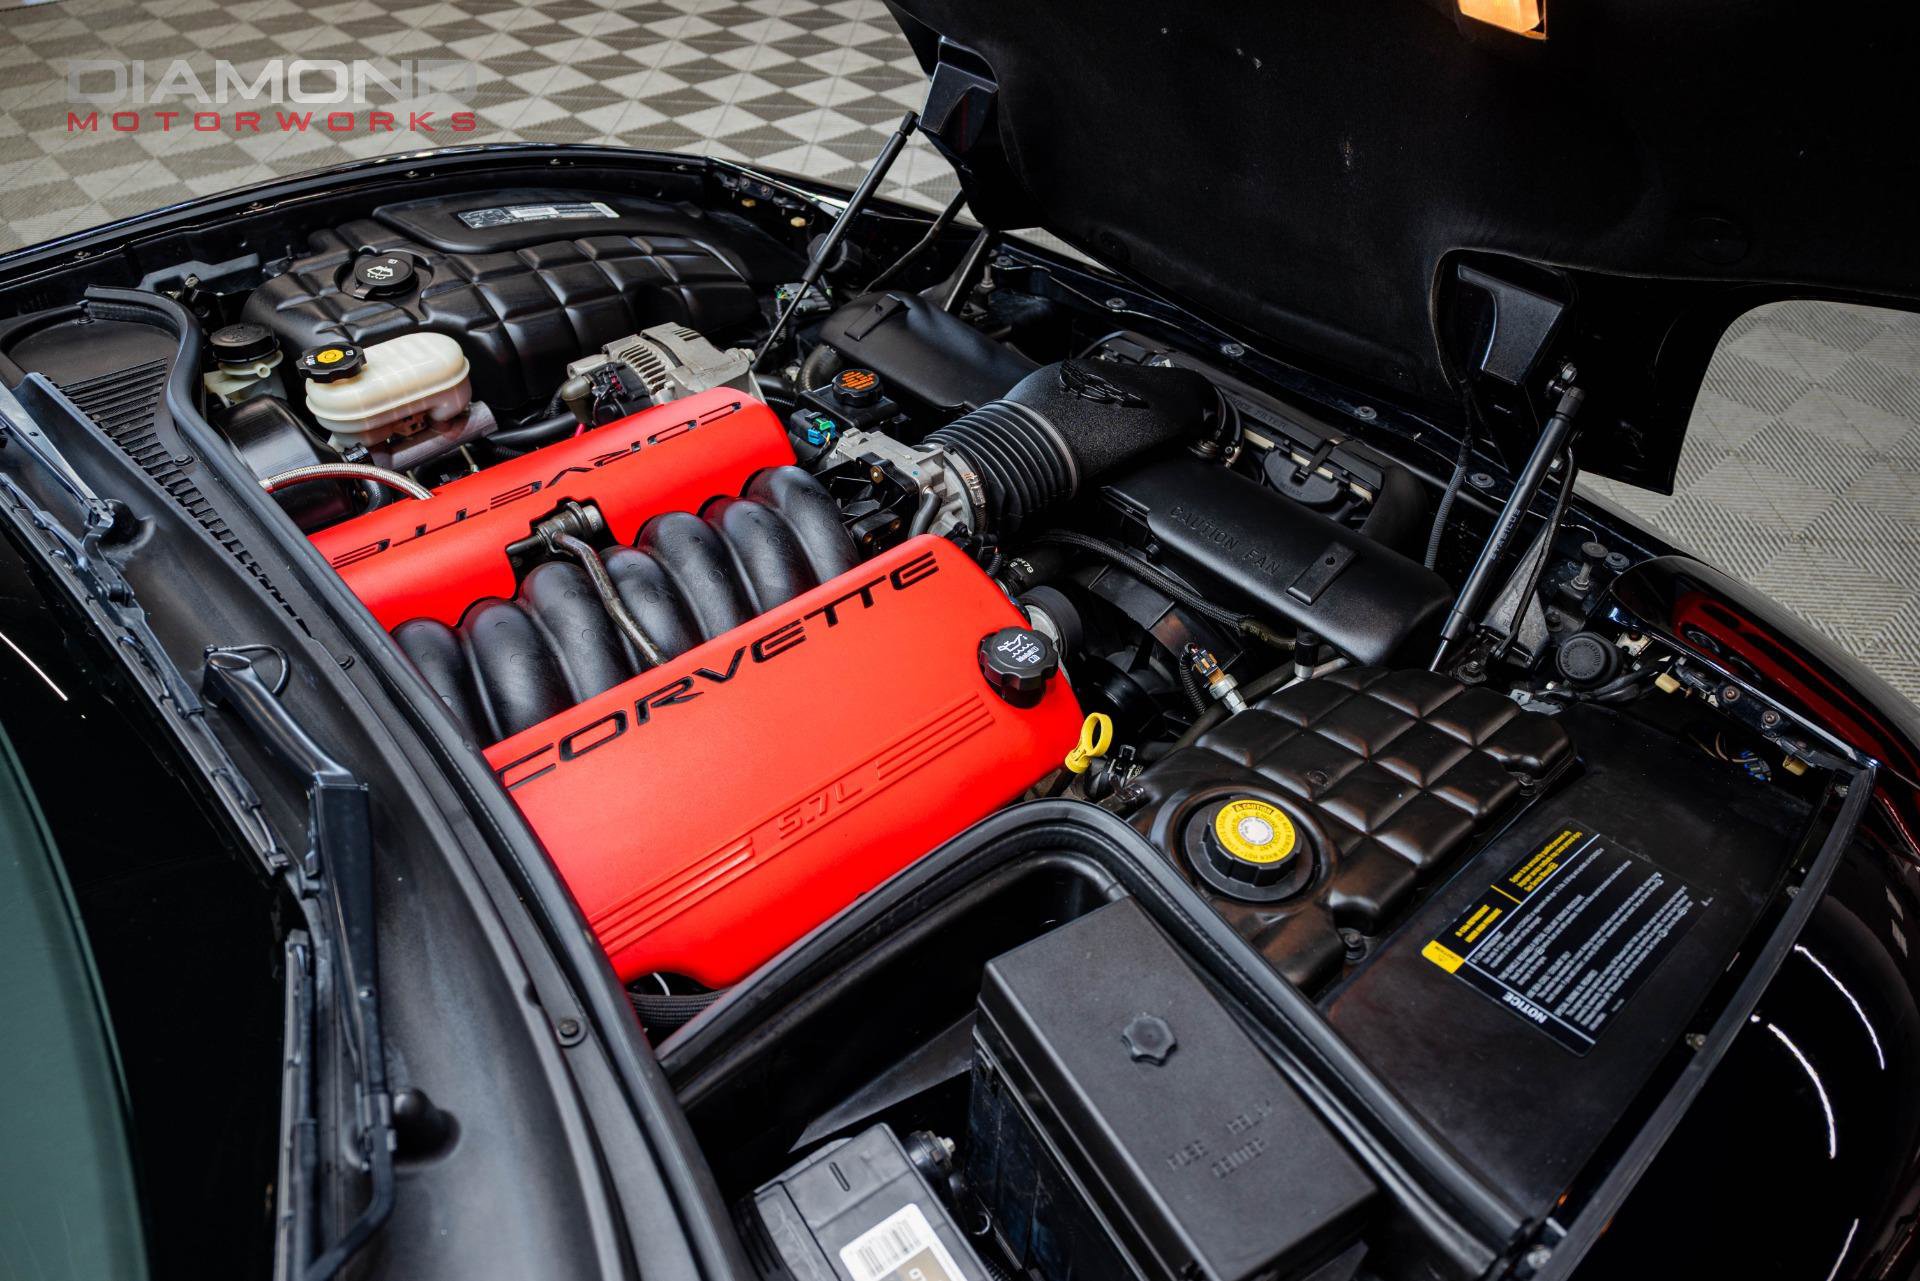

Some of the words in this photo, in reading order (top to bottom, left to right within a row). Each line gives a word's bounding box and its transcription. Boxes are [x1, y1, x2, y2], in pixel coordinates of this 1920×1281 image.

[332, 401, 742, 569] CORVETTE
[1170, 505, 1240, 553] CAUTION
[1241, 548, 1281, 577] FAN
[496, 551, 940, 790] CORVETTE
[778, 781, 863, 840] 5.7L
[1502, 991, 1548, 1024] NOTICE
